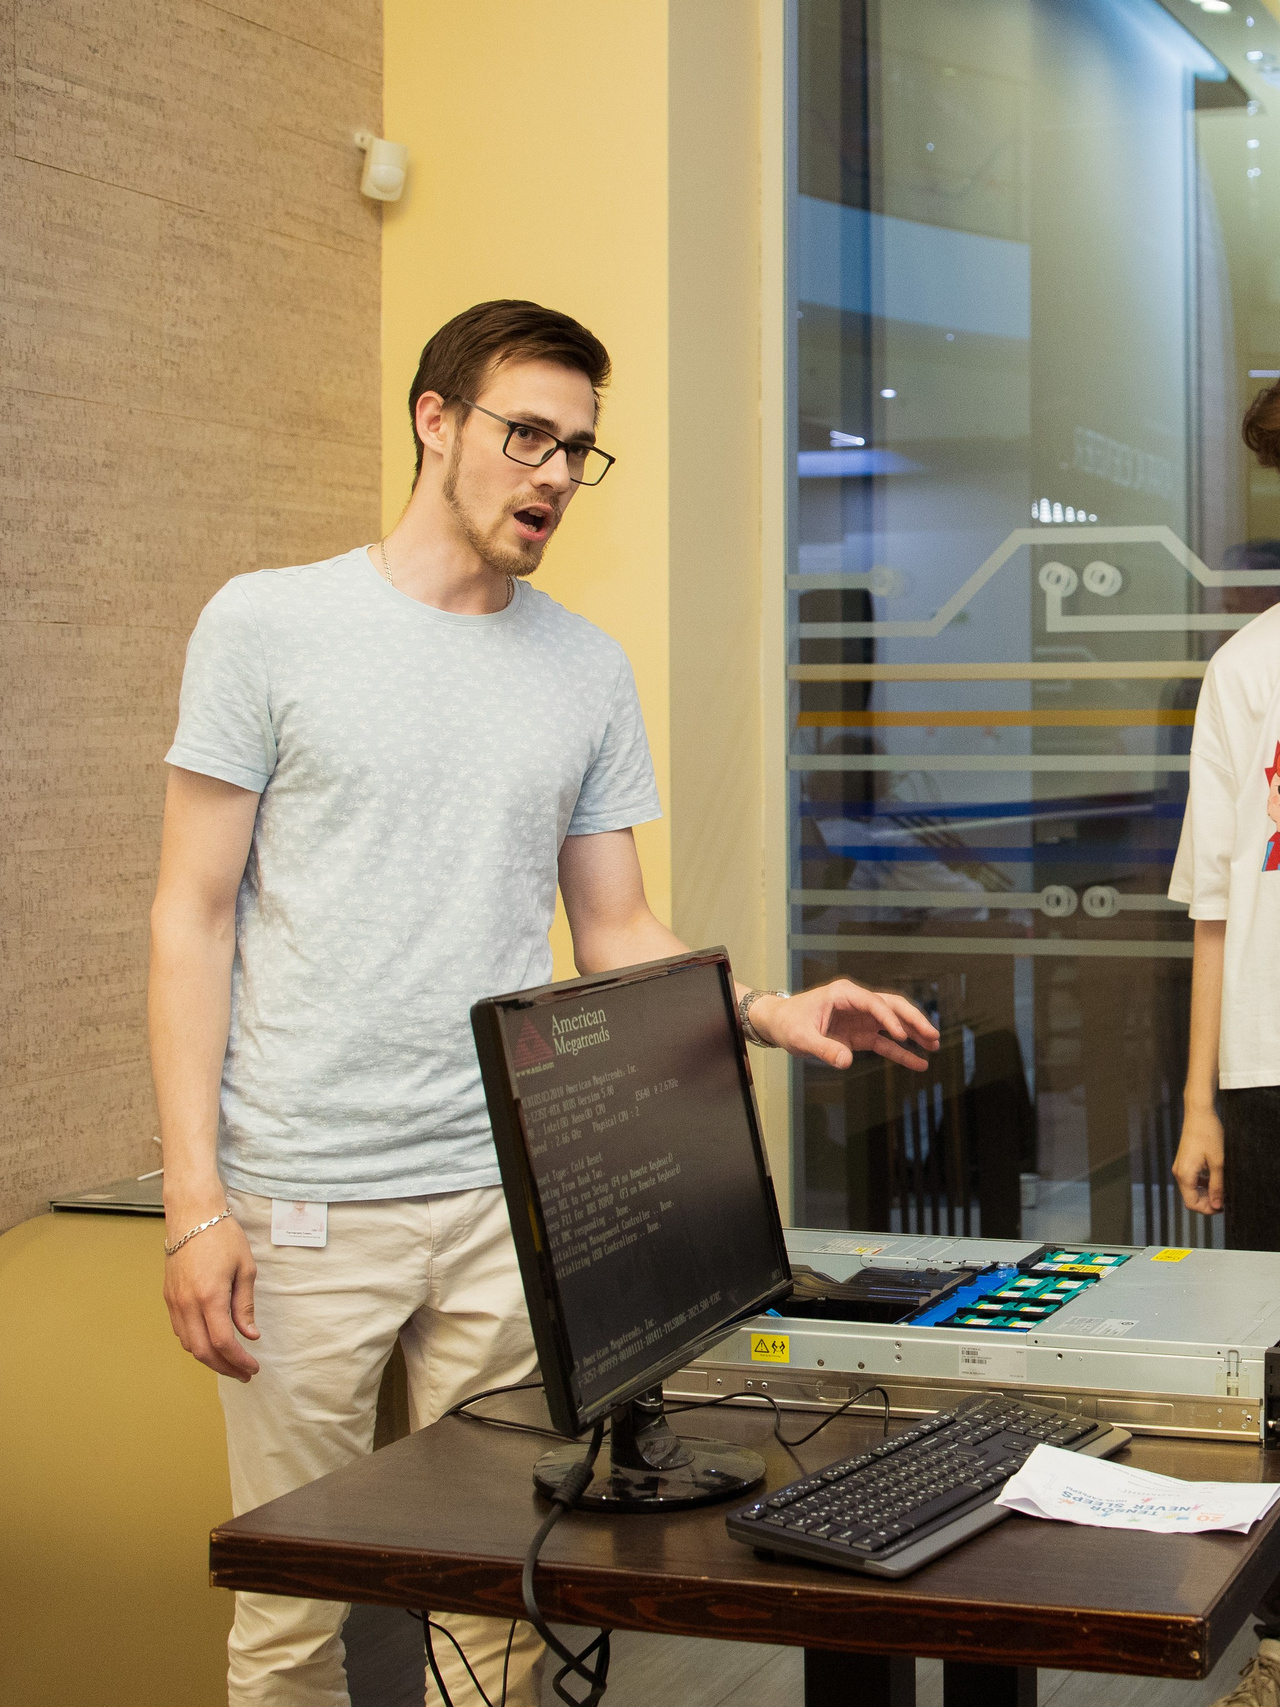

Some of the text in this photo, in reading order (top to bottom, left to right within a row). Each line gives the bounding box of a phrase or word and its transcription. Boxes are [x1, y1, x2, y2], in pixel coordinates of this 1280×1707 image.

[551, 1007, 607, 1036] American
[553, 1026, 610, 1056] Megatrends
[566, 1080, 592, 1094] American
[627, 1064, 639, 1074] Inc.
[578, 1092, 600, 1106] Version
[543, 1116, 568, 1135] Intel(R)
[571, 1109, 593, 1124] Xeon(R)
[595, 1103, 606, 1115] CPU
[556, 1133, 570, 1147] 2.66
[571, 1128, 582, 1141] GHz
[592, 1115, 617, 1133] Physical
[618, 1110, 629, 1122] CPU
[571, 1158, 585, 1173] Cold
[586, 1152, 603, 1166] Reset
[561, 1180, 575, 1194] From
[571, 1195, 579, 1206] to
[592, 1183, 609, 1199] Setup
[621, 1174, 629, 1183] on
[629, 1165, 648, 1180] Remote
[649, 1152, 674, 1170] Keyboard)
[574, 1209, 584, 1221] for
[630, 1186, 637, 1195] on
[638, 1176, 656, 1191] Remote
[657, 1163, 681, 1183] Keyboard)
[574, 1216, 606, 1237] responding
[589, 1223, 621, 1246] Management
[621, 1210, 650, 1230] Controller
[604, 1232, 638, 1255] Controllers
[583, 1346, 609, 1368] American
[1061, 1490, 1191, 1512] NEVER SLEEPS
[1090, 1505, 1158, 1516] TENSOR
[1196, 1514, 1224, 1522] 20
